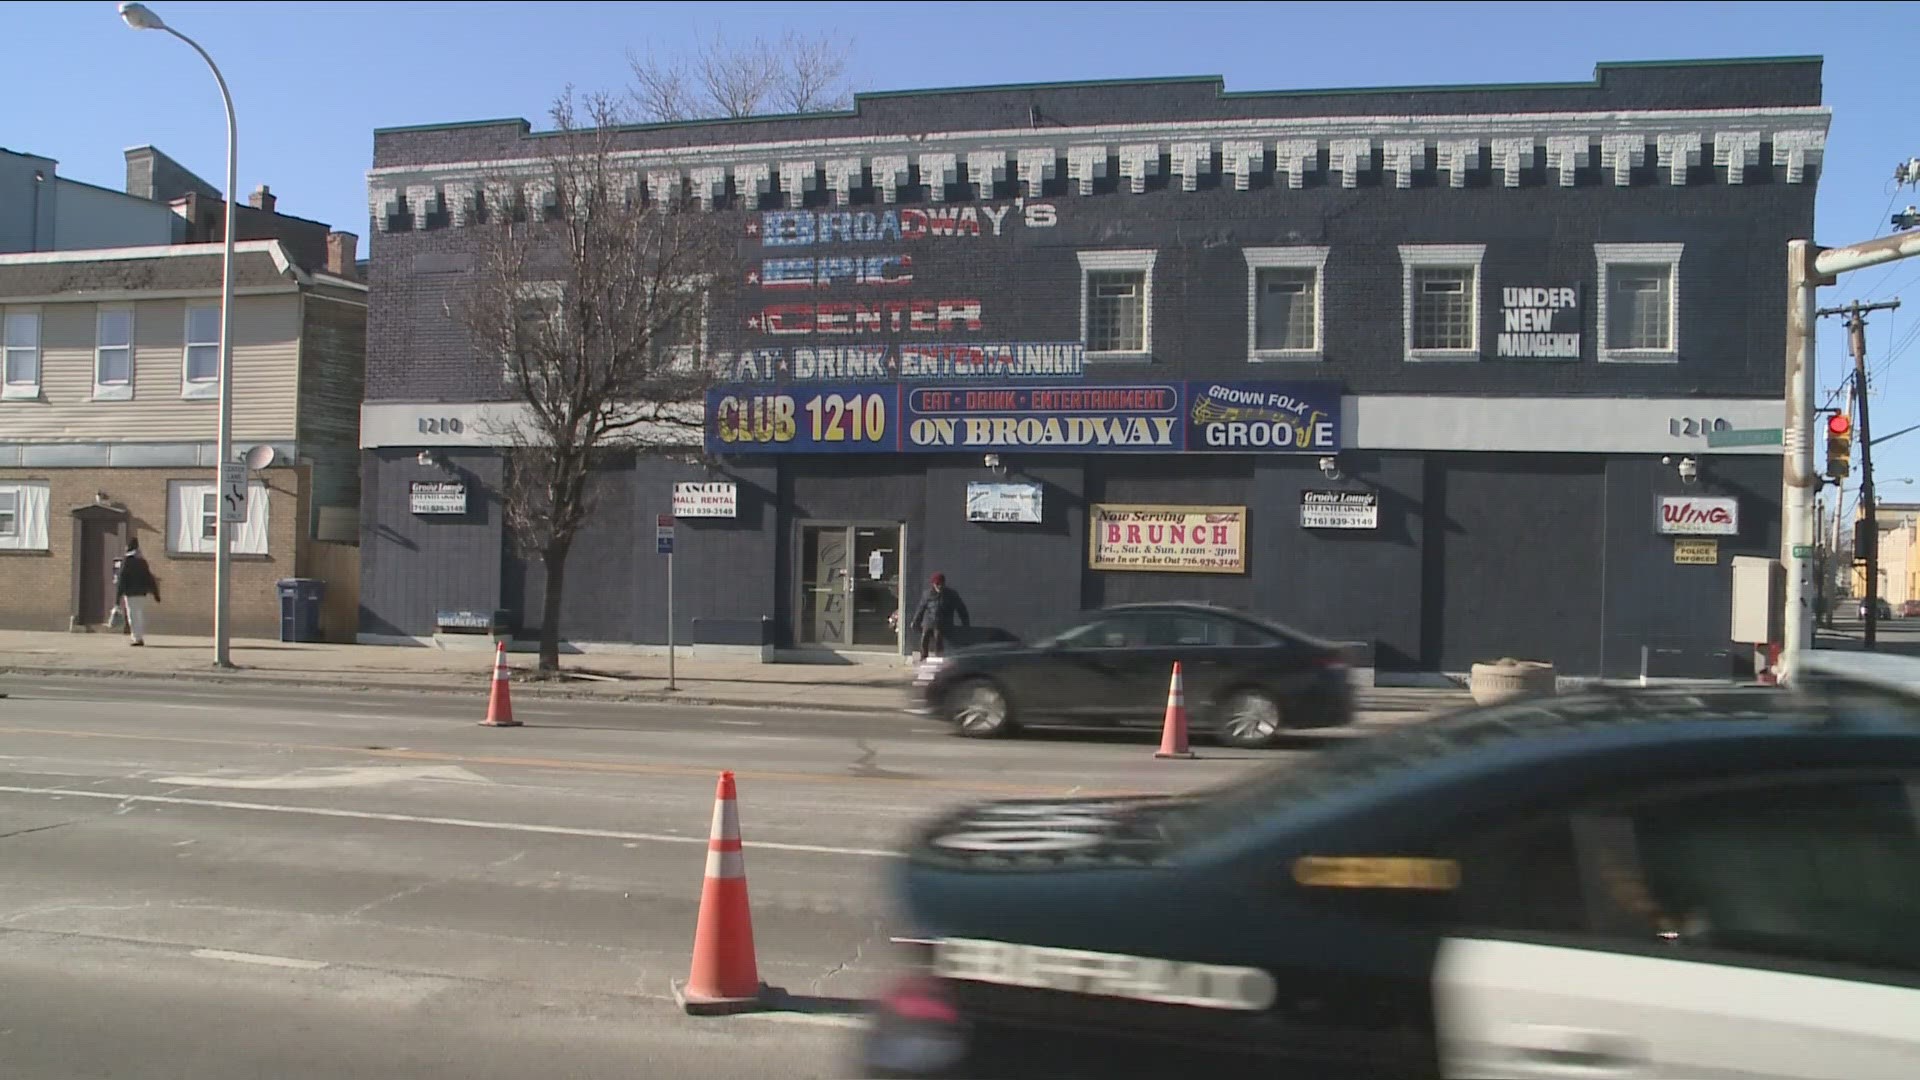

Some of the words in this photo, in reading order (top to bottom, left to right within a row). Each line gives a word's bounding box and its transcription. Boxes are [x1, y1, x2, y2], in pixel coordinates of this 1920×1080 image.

[761, 197, 1058, 247] BROADWAY'S
[761, 254, 914, 290] EPIC
[1503, 287, 1576, 308] UNDER
[760, 300, 983, 334] CENTER
[1505, 308, 1552, 332] NEW
[793, 345, 889, 381] DRINK
[923, 391, 951, 410] EAT
[966, 391, 1017, 410] DRINK
[1031, 389, 1165, 411] ENTERTAINMENT
[1208, 384, 1265, 406] GROWN
[1267, 394, 1309, 416] FOLK
[418, 417, 459, 433] 1210
[718, 395, 796, 442] CLUB
[805, 393, 886, 441] 1210
[1669, 418, 1726, 435] 1210
[910, 418, 959, 446] ON
[962, 417, 1177, 446] BROADWAY
[1304, 492, 1339, 503] Groove
[1340, 493, 1374, 504] Lounge
[1099, 511, 1130, 522] Now
[1132, 511, 1185, 524] Serving
[1303, 517, 1327, 526] (716)
[1330, 518, 1373, 526] 939-3149
[1107, 524, 1227, 545] BRUNCH
[1141, 556, 1162, 564] Take
[1144, 546, 1152, 554] &
[1154, 546, 1177, 554] Sun.
[437, 617, 490, 627] BREAKFAST
